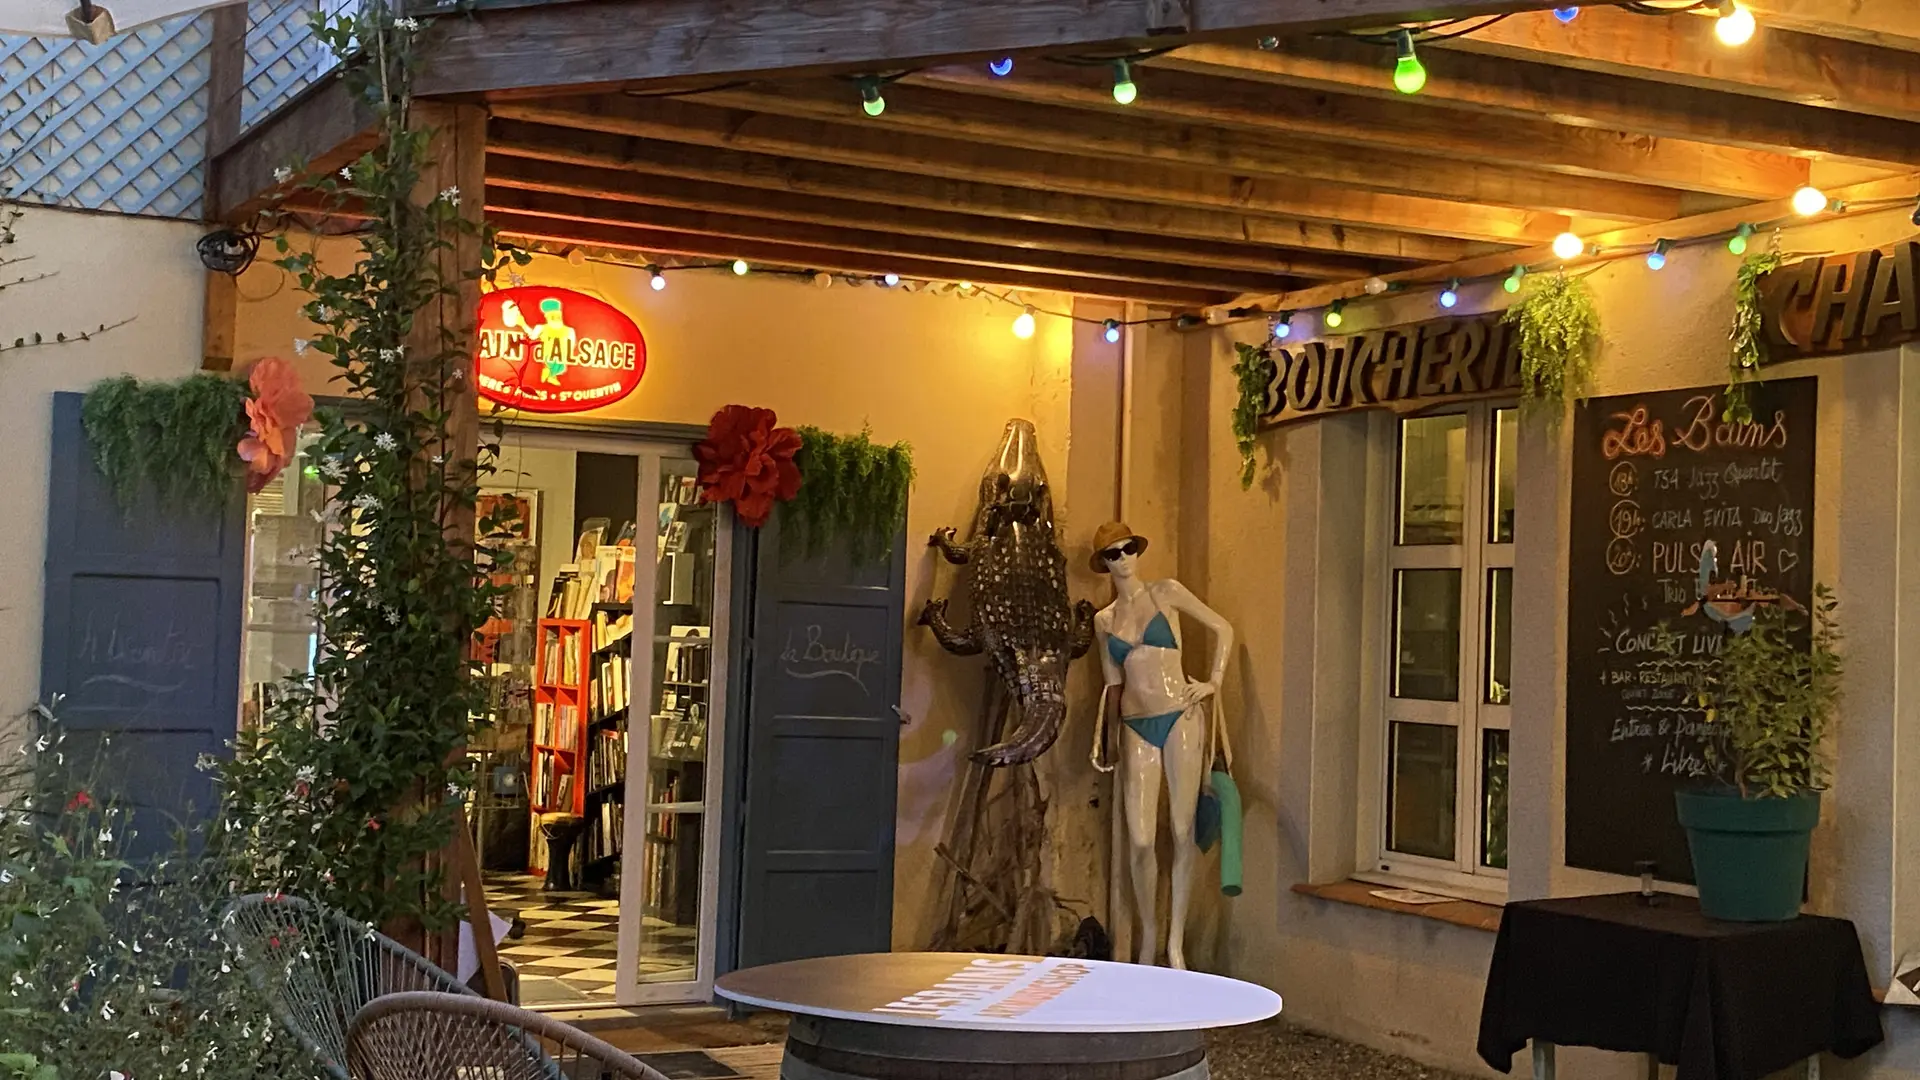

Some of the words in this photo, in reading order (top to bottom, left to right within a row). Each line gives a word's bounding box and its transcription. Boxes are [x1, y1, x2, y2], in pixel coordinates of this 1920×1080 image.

[1603, 406, 1665, 457] Les
[1672, 394, 1787, 451] Bains
[1652, 508, 1692, 529] CARLA
